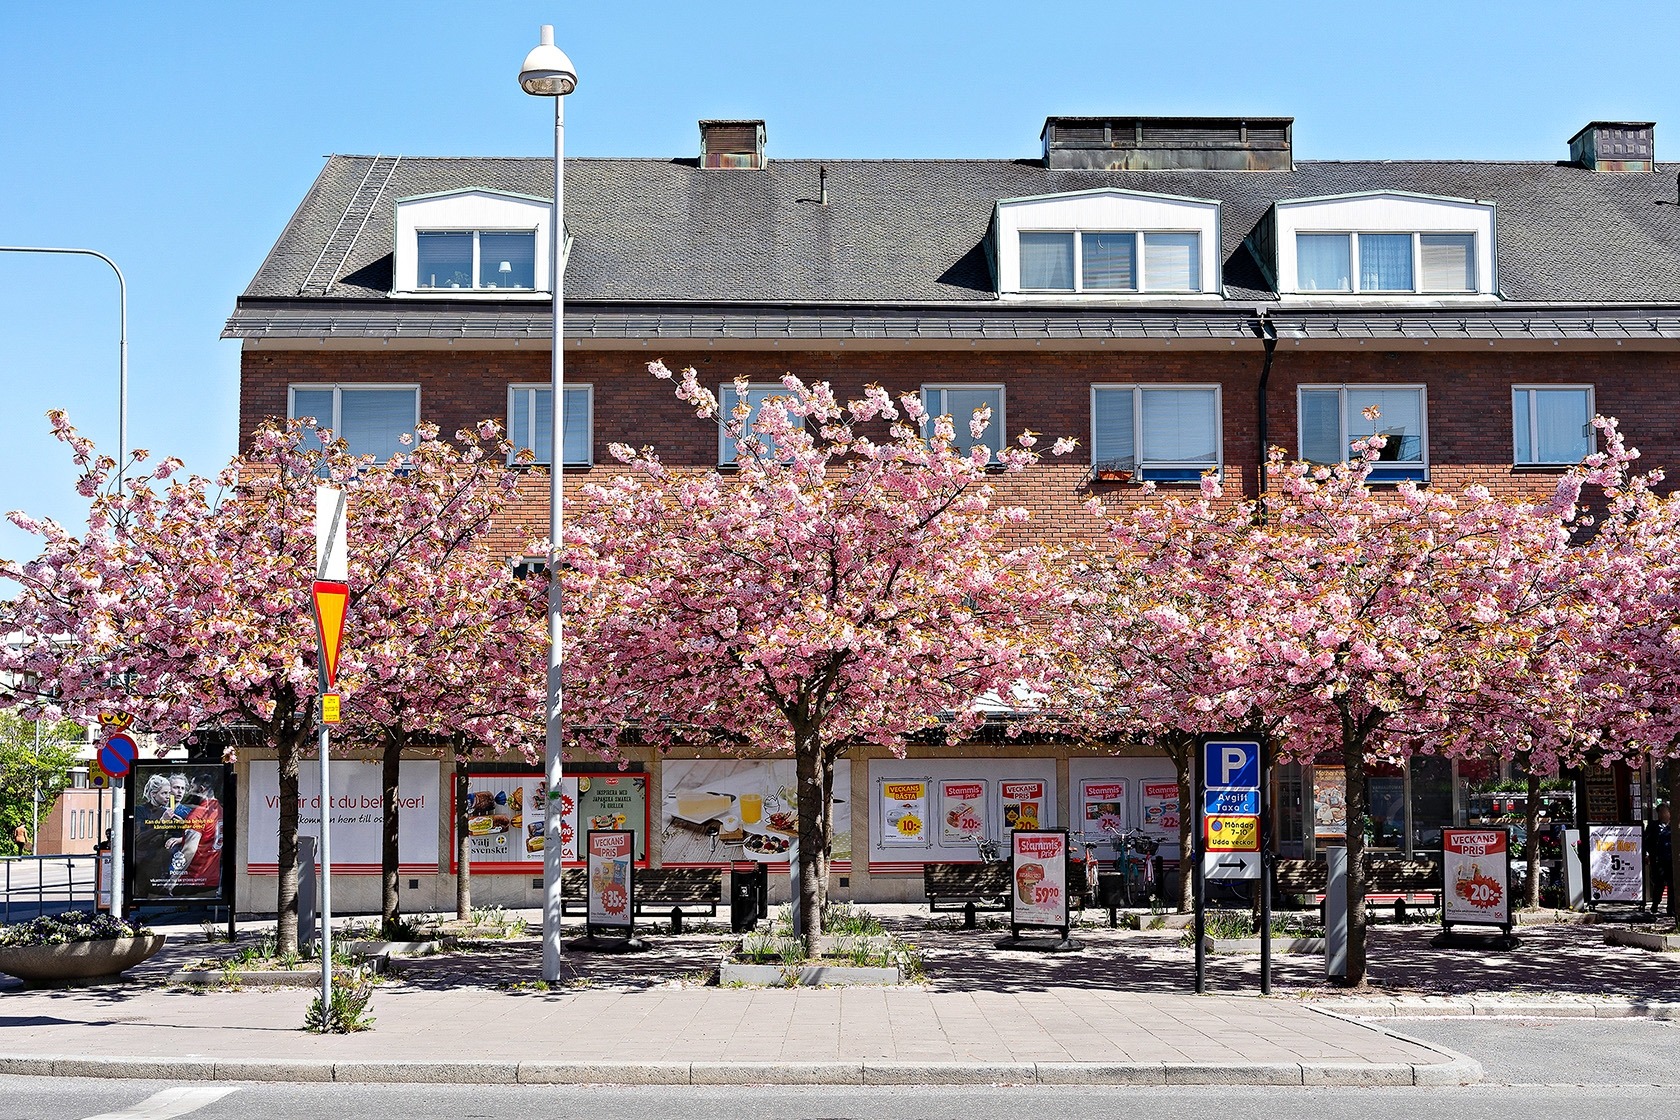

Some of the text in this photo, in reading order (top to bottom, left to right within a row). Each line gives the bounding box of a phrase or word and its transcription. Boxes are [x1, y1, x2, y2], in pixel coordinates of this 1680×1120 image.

[1222, 747, 1246, 784] P
[889, 785, 920, 793] VECKANS
[948, 786, 980, 795] Stammis
[1088, 786, 1120, 795] Stammis
[1148, 786, 1179, 795] Stammis
[895, 792, 916, 800] BÄSTA
[1218, 794, 1248, 803] Avgift
[265, 795, 278, 808] Vi
[311, 795, 335, 808] dt
[338, 795, 357, 808] du
[361, 795, 425, 808] behver!
[338, 814, 356, 823] hem
[358, 814, 371, 823] till
[902, 820, 920, 831] 10:-
[962, 818, 981, 829] 20:-
[1224, 821, 1254, 830] Måndag
[471, 838, 490, 847] Välj
[595, 836, 624, 847] VECKANS
[1452, 835, 1495, 844] VECKANS
[1021, 840, 1059, 851] Stammis
[1462, 846, 1484, 854] PRIS
[602, 848, 616, 857] PRIS
[1611, 855, 1630, 871] 5:-
[1471, 884, 1500, 901] 20:-
[607, 890, 625, 907] 35:-
